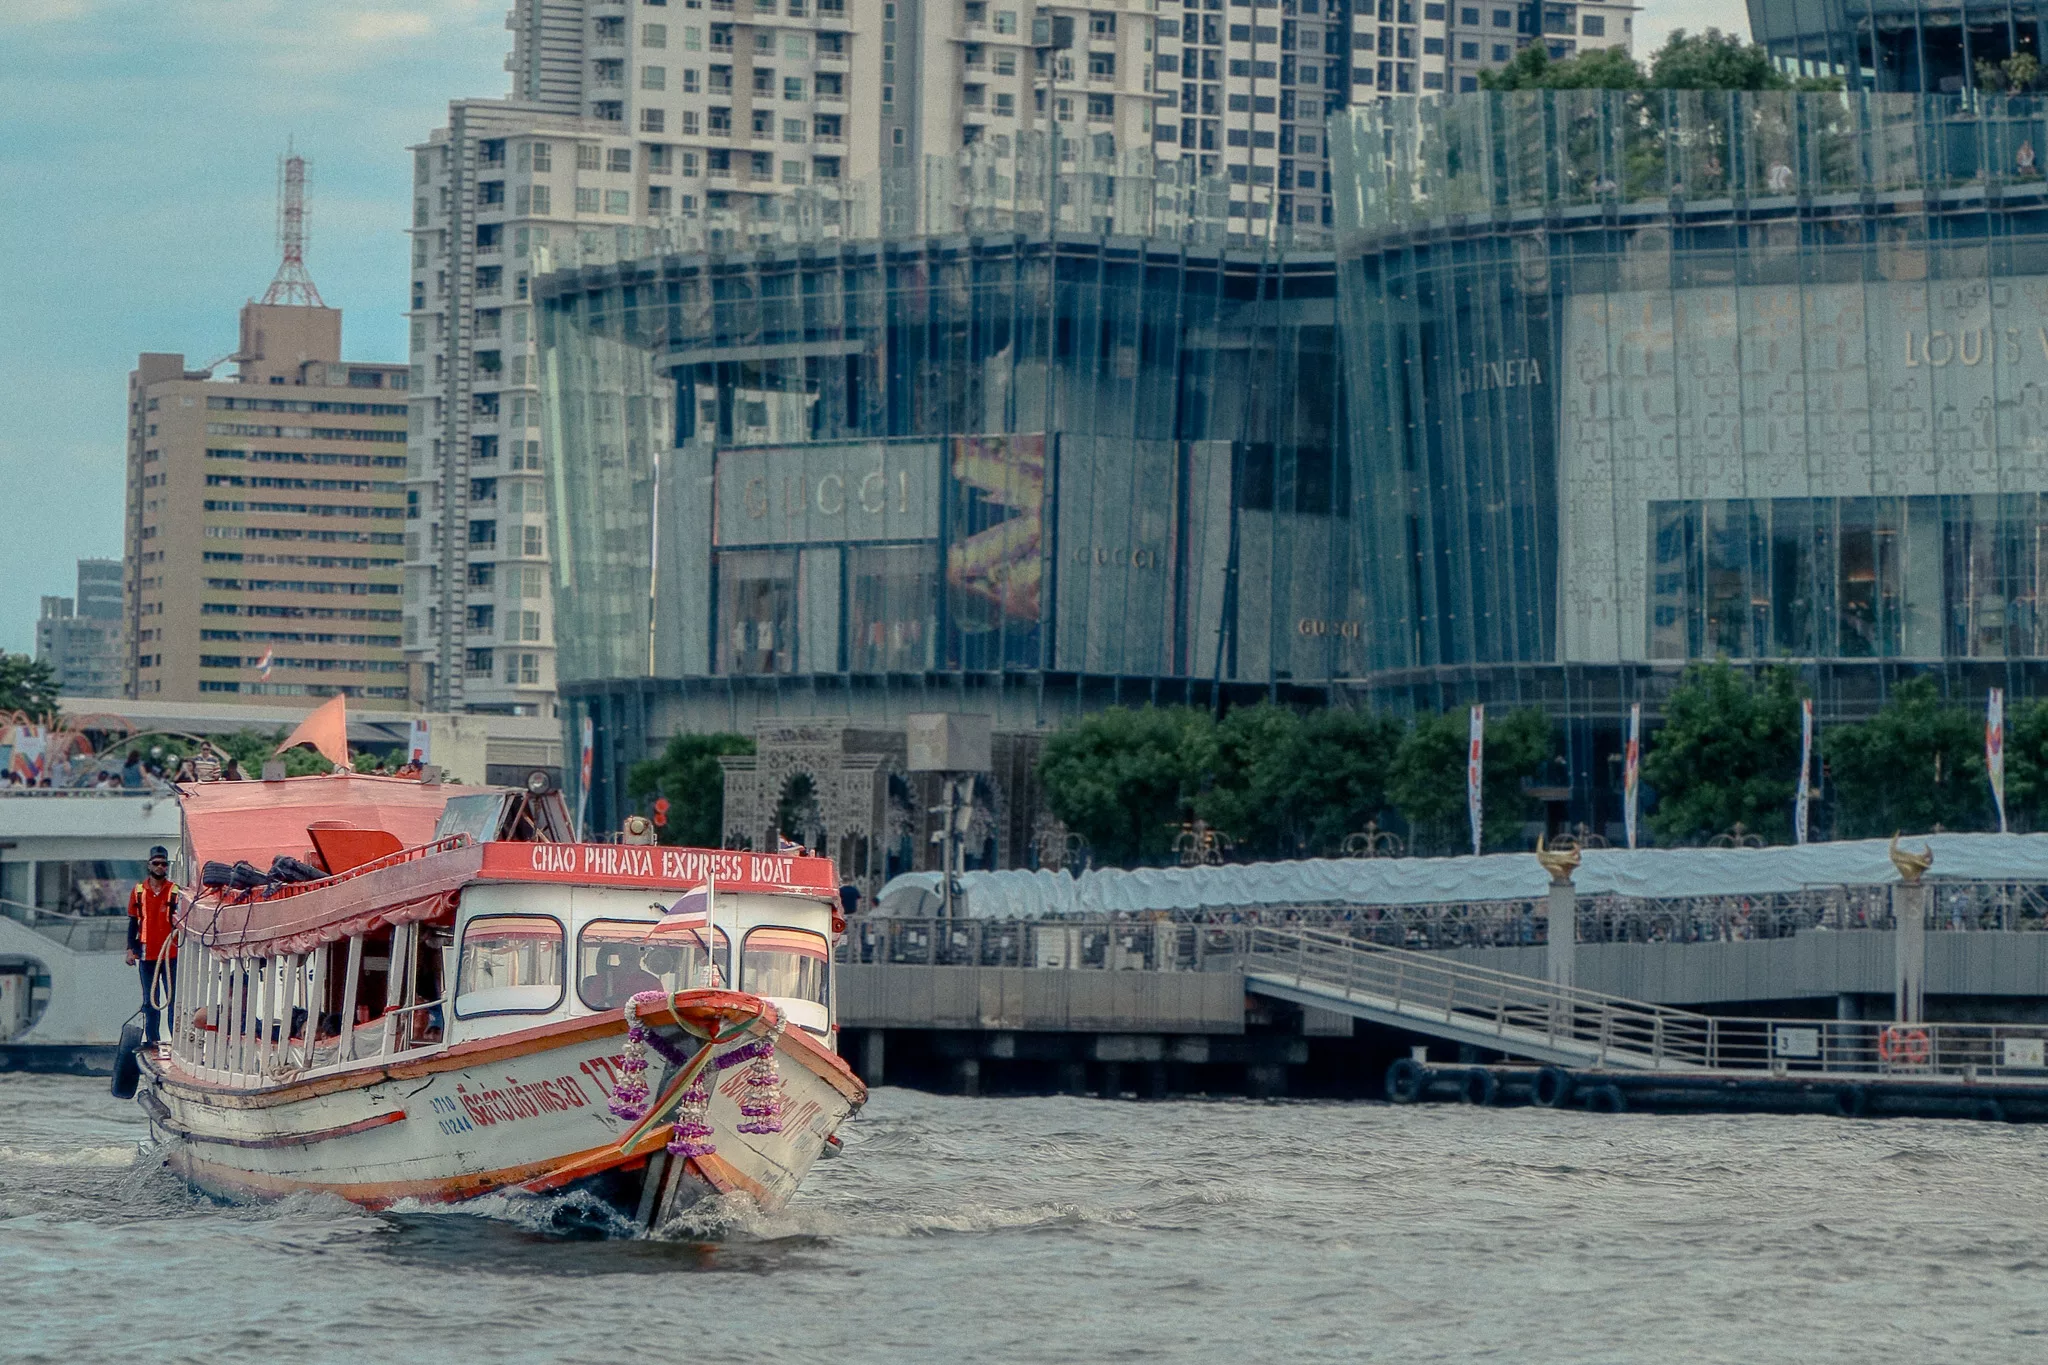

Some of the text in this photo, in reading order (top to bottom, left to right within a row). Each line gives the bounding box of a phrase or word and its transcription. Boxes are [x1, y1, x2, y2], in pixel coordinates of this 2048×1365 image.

[1905, 327, 2021, 368] LOUIS
[1456, 357, 1543, 394] NETA
[1299, 618, 1360, 638] GUCI
[531, 845, 794, 884] CHAO PHRAYA EXPRESS BOAT
[580, 1054, 645, 1099] 17
